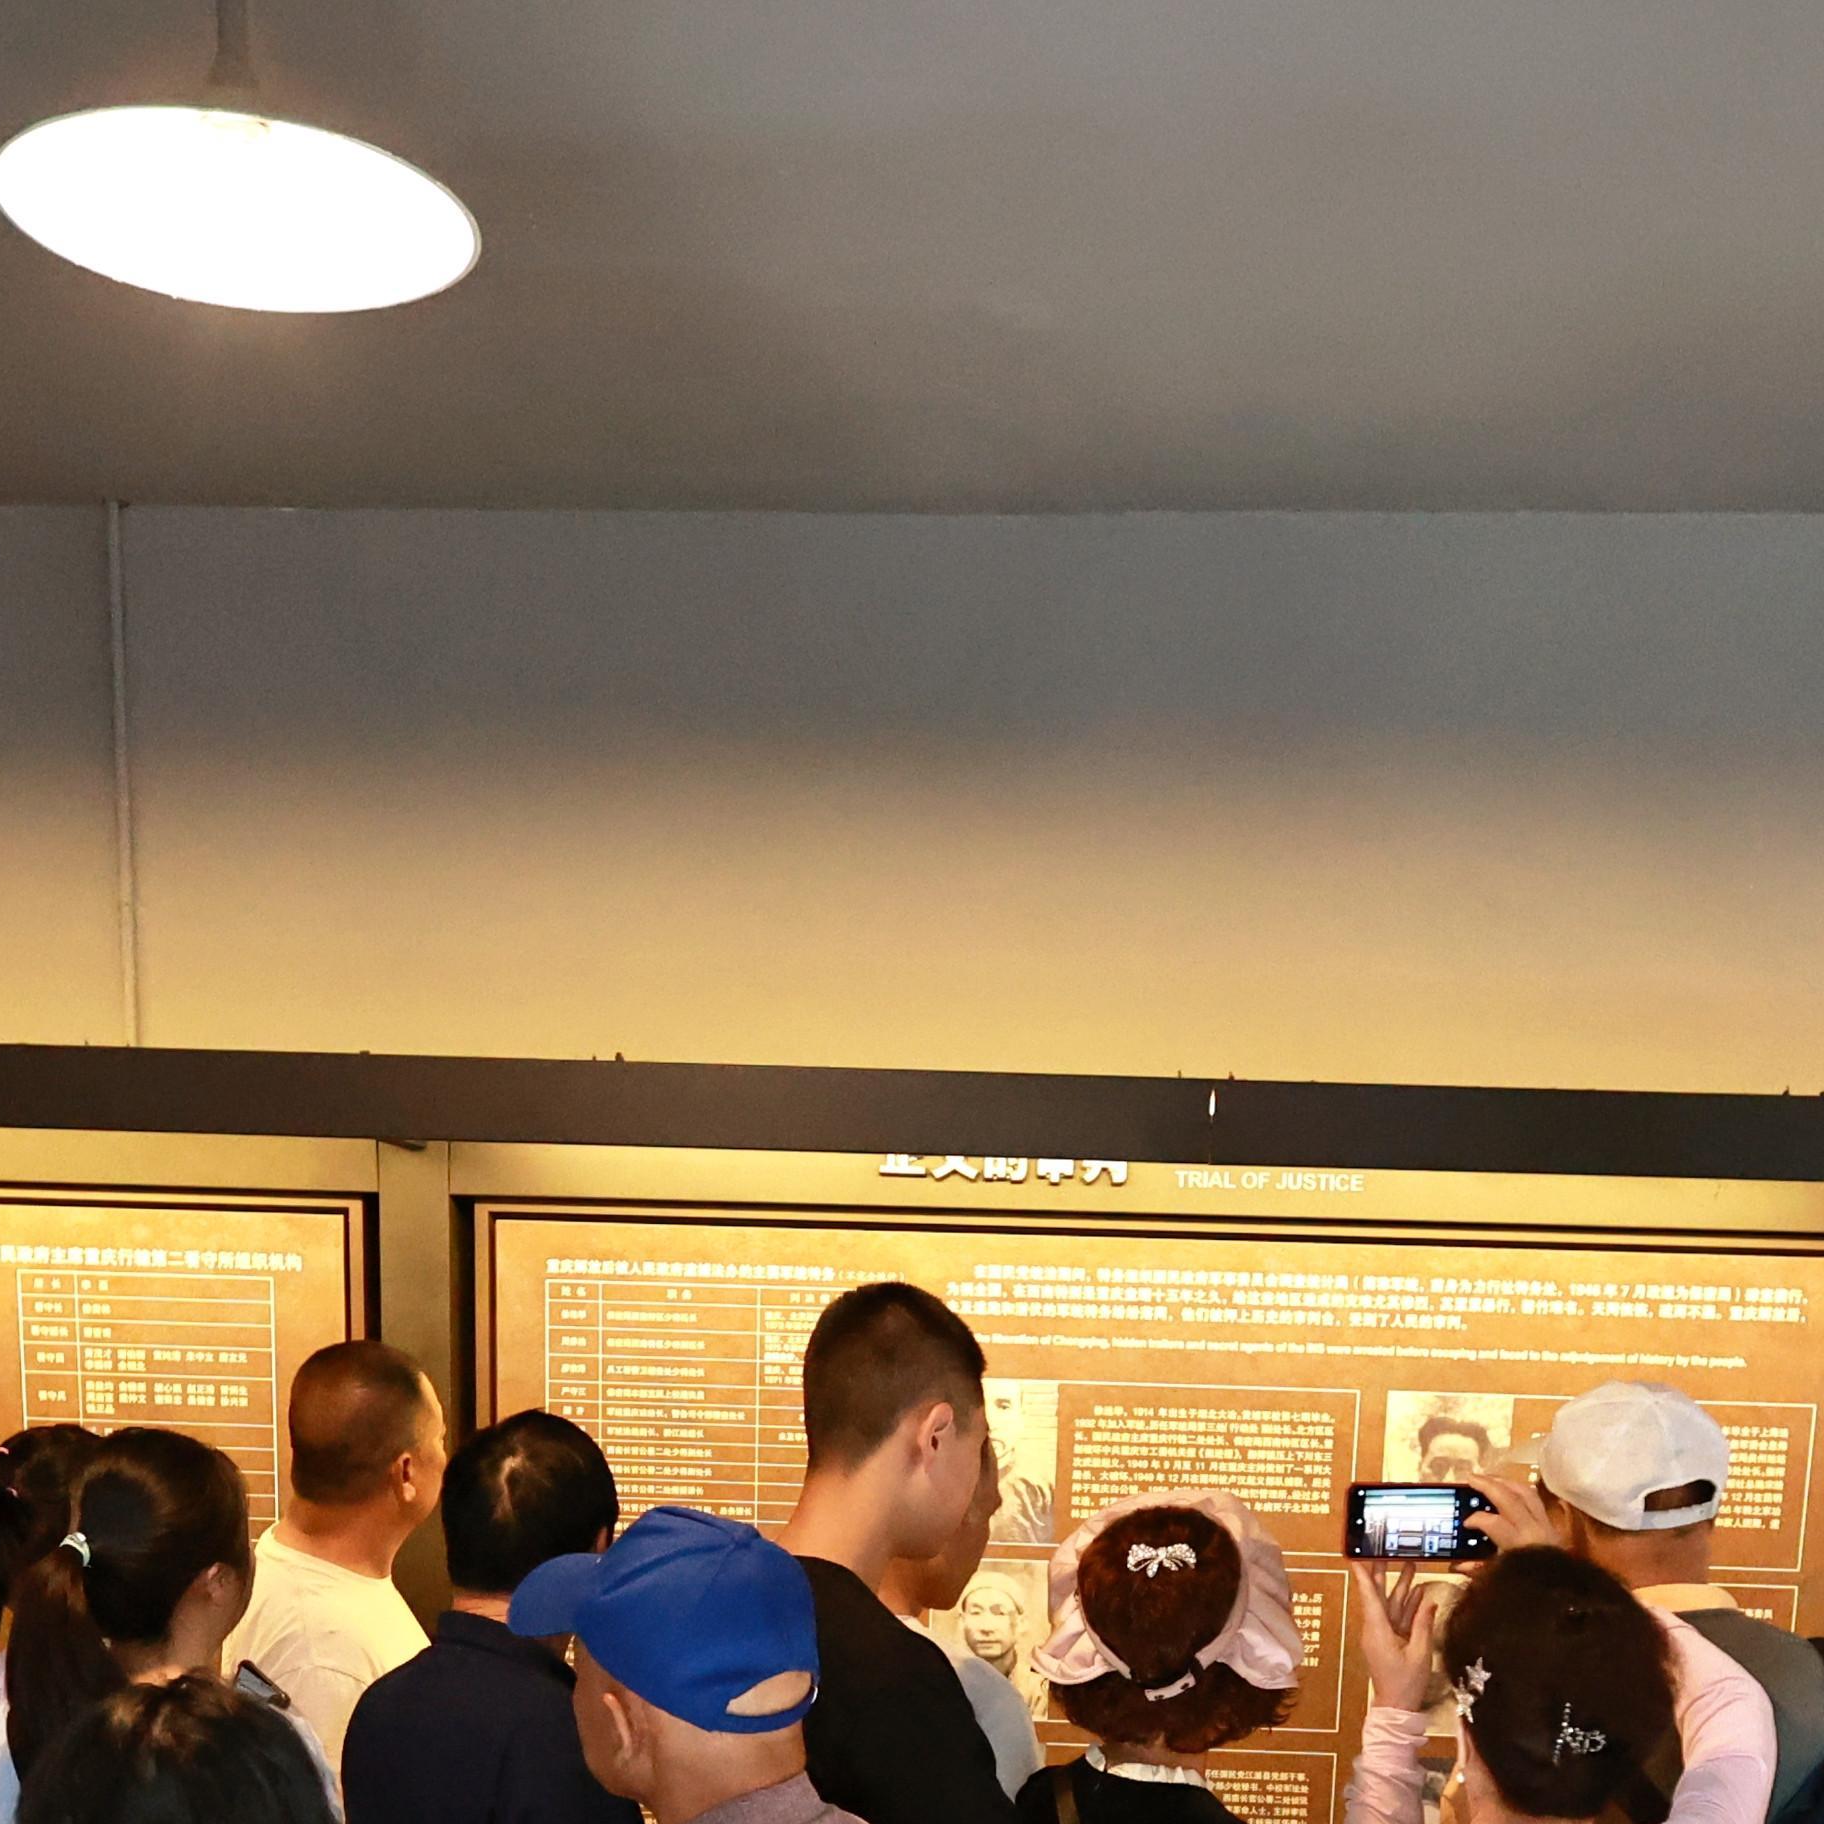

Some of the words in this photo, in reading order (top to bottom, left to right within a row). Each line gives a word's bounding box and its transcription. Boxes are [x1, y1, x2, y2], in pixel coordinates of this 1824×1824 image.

[1175, 1170, 1236, 1189] TRIAL
[1241, 1171, 1269, 1190] OF
[1275, 1172, 1364, 1192] JUSTICE
